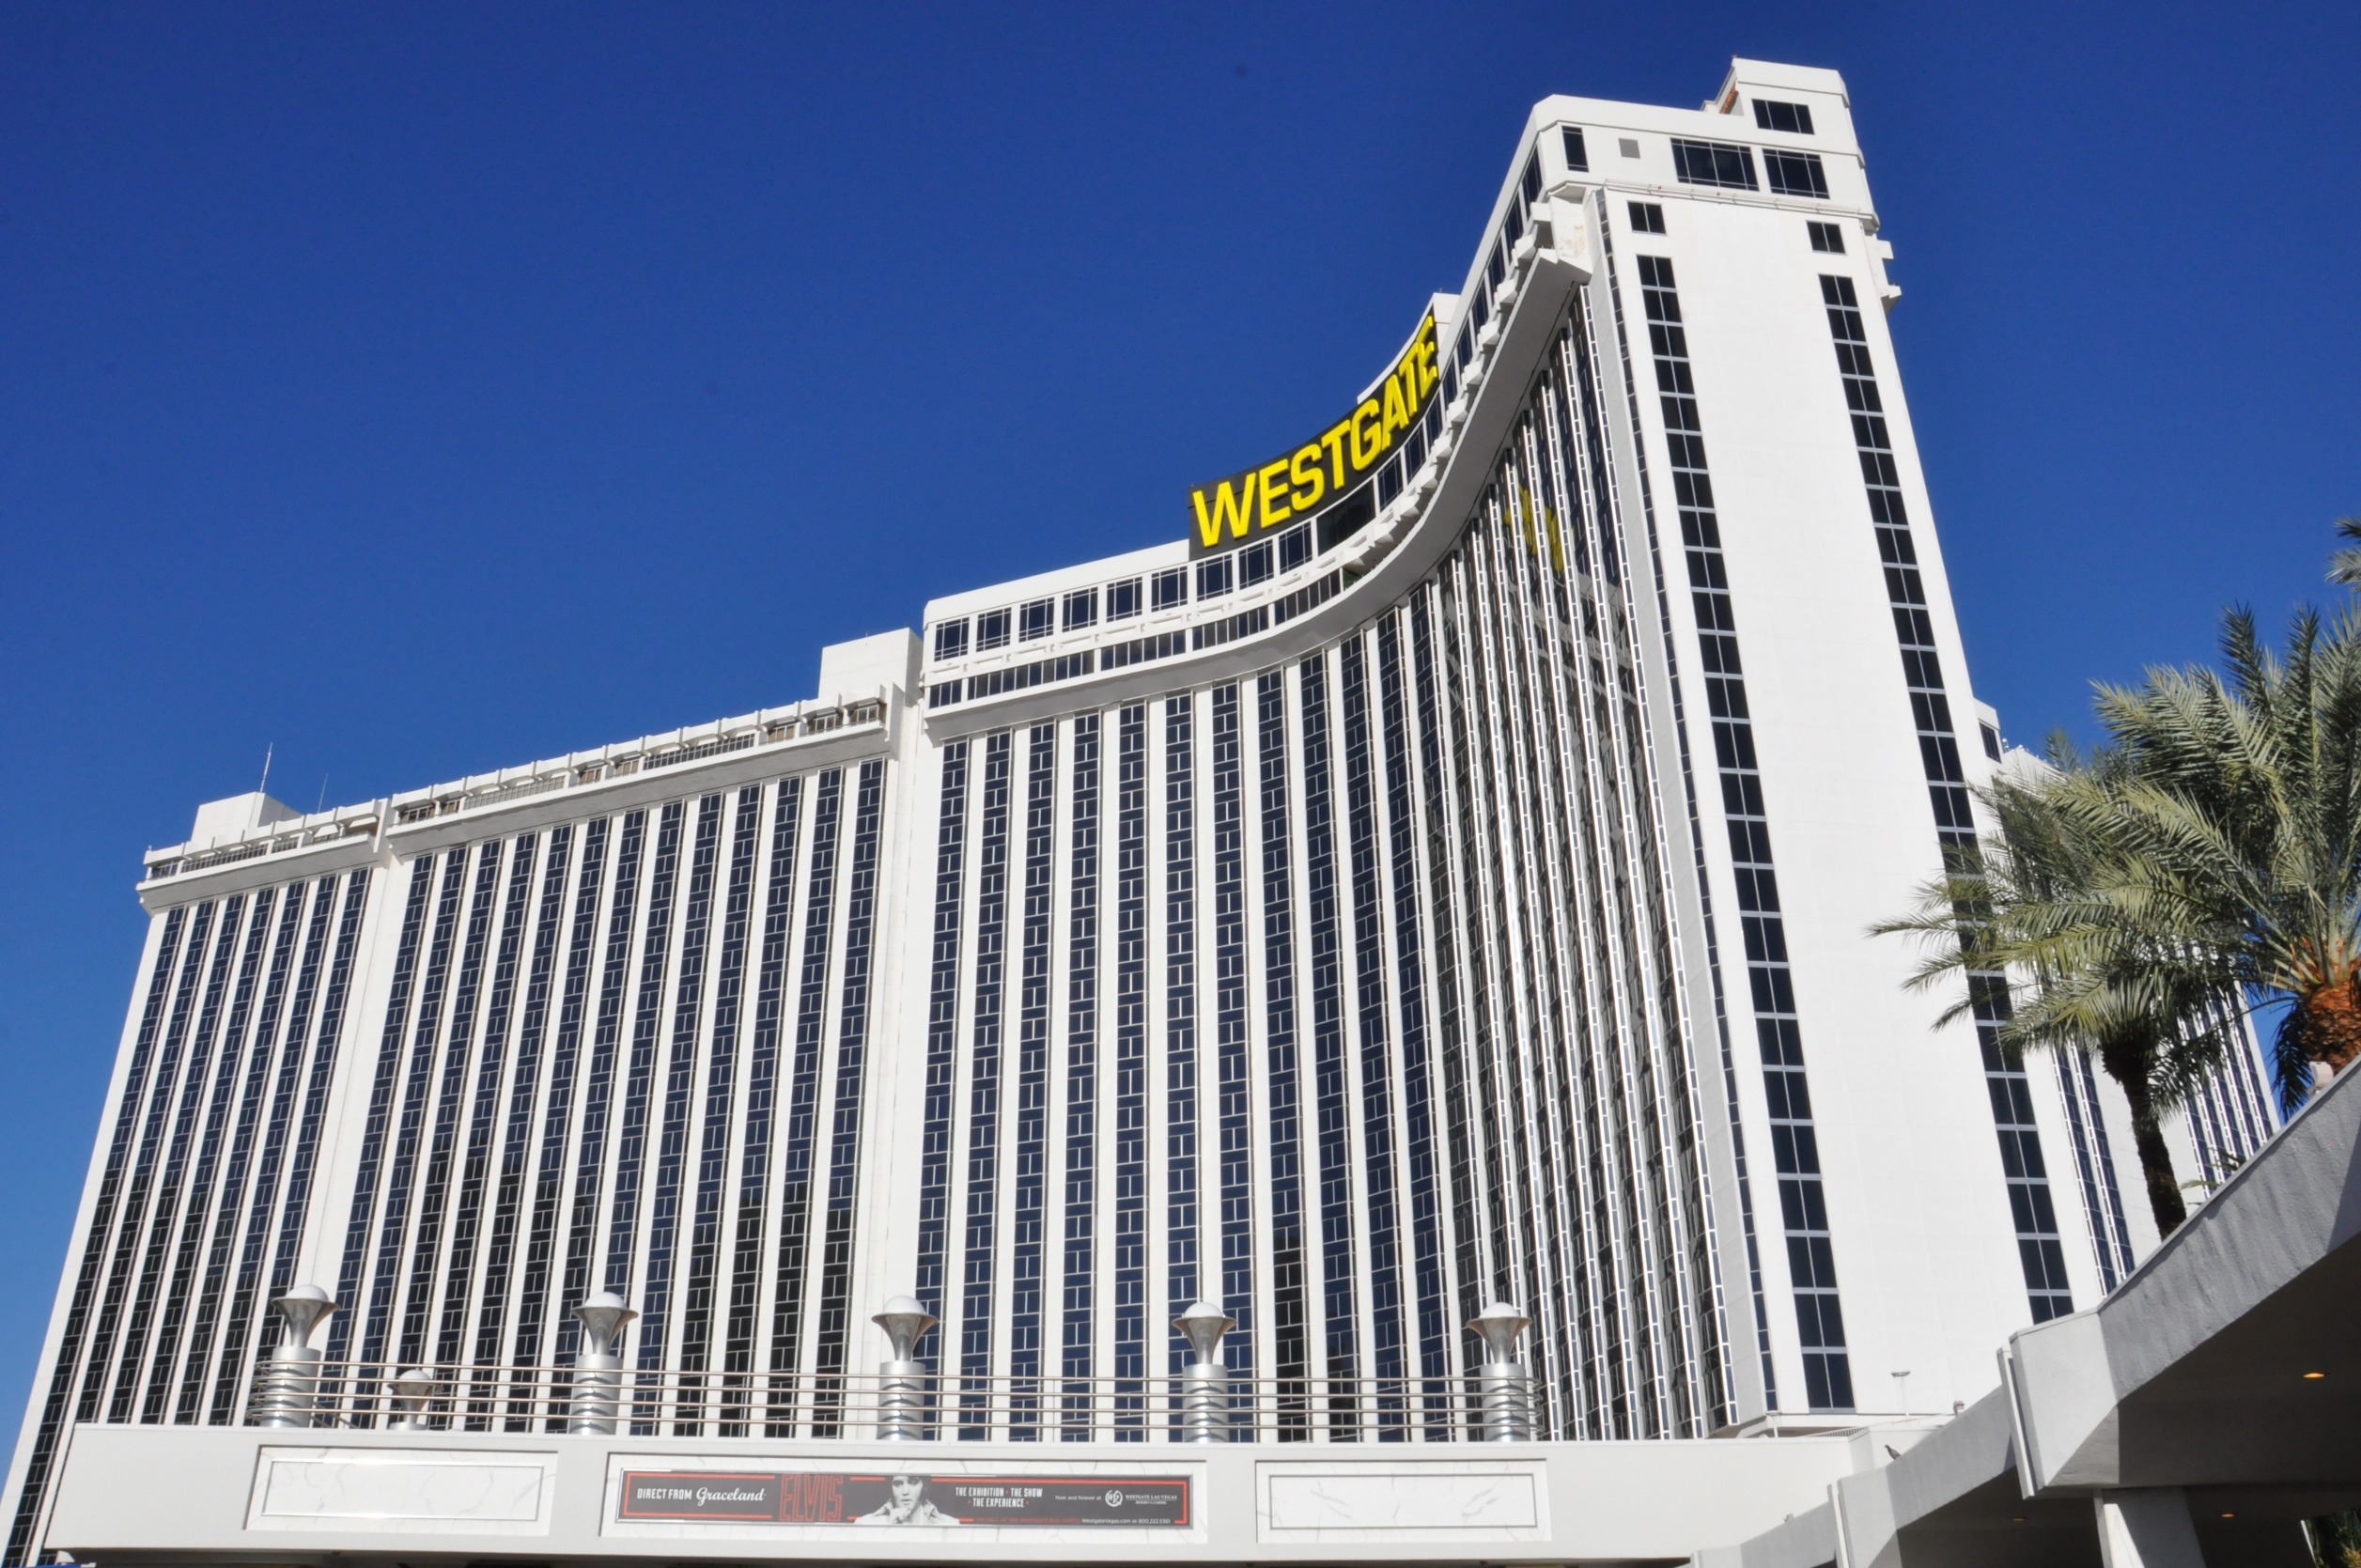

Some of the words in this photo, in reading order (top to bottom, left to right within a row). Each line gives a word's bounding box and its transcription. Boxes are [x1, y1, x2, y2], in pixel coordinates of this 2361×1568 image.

[1192, 316, 1437, 548] WESTGATE
[637, 1487, 668, 1499] DIRECT
[668, 1489, 692, 1500] FROM
[696, 1487, 765, 1507] Graceland
[779, 1473, 844, 1522] ELVIS
[955, 1487, 967, 1497] THE
[969, 1487, 1004, 1497] EXHIBITION
[1011, 1488, 1022, 1498] THE
[1024, 1488, 1043, 1498] SHOW
[973, 1498, 985, 1507] THE
[986, 1498, 1024, 1508] EXPERIENCE
